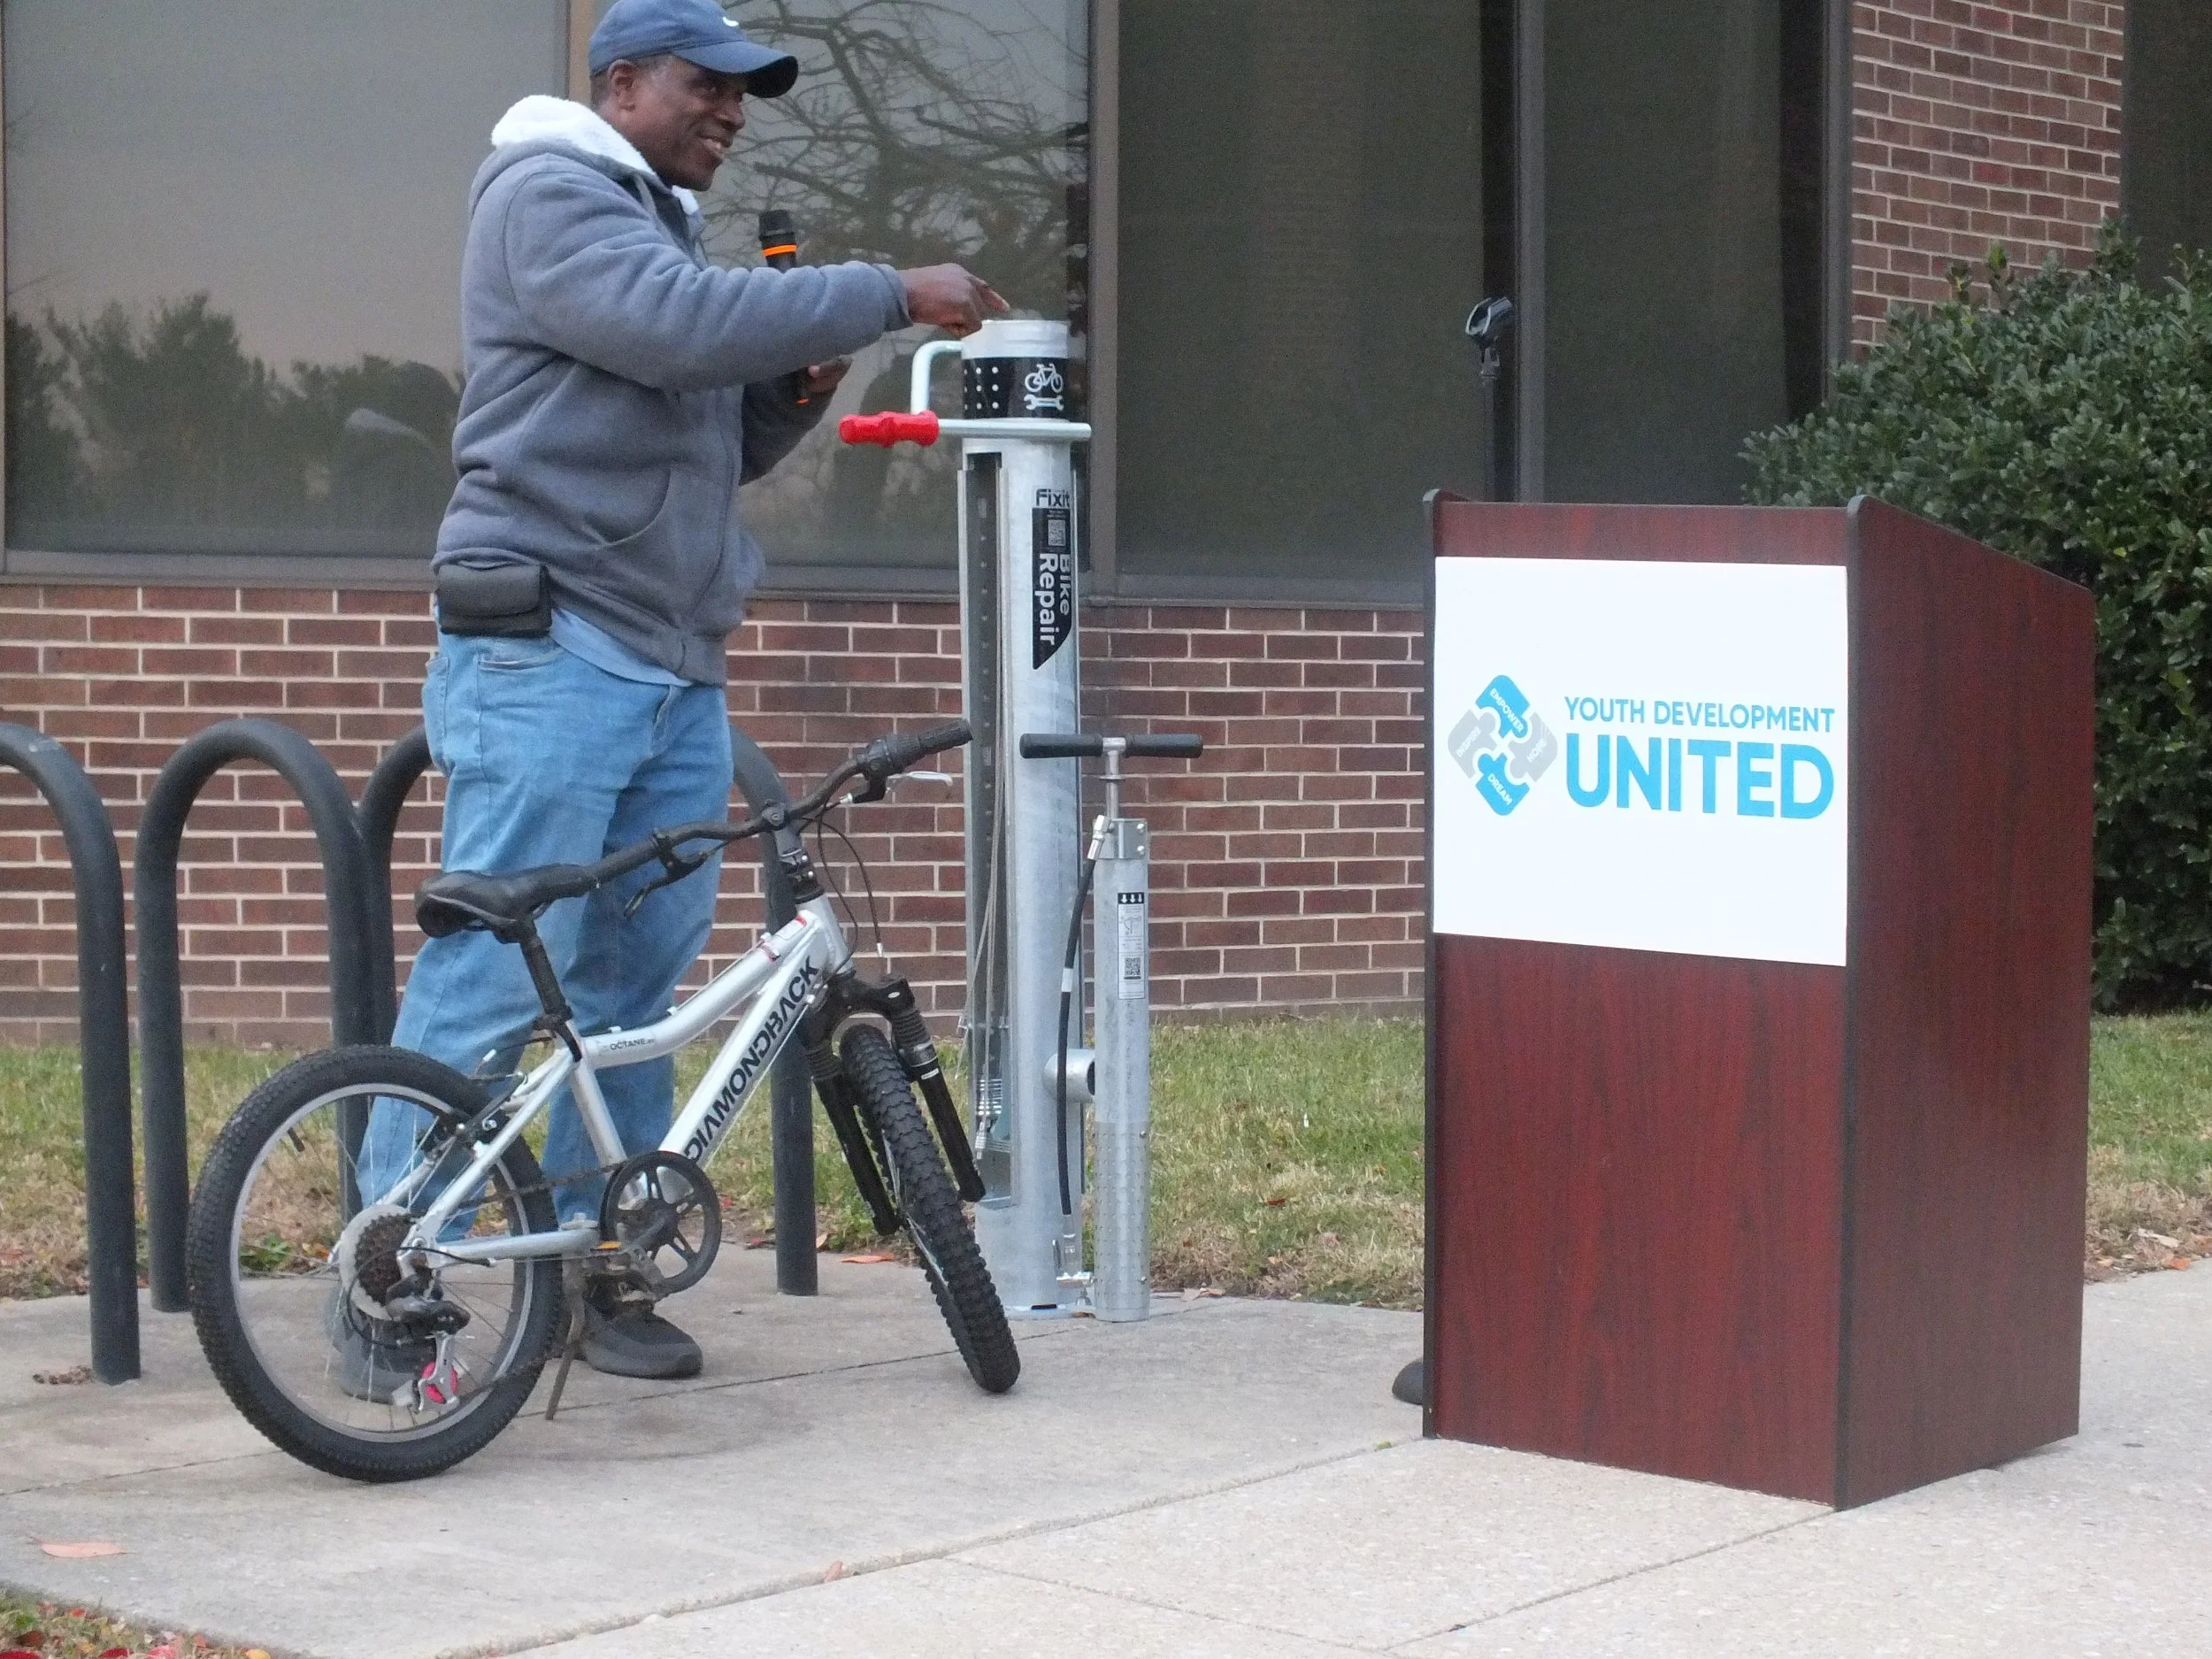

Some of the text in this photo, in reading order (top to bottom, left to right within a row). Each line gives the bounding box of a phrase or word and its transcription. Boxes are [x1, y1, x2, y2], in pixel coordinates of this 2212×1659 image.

[1036, 488, 1071, 508] Fixit
[1034, 553, 1060, 646] Repair
[1059, 553, 1071, 617] Bike
[1489, 687, 1525, 733] EMPOWER
[1564, 696, 1835, 733] YOUTH DEVELOPMENT
[1455, 726, 1482, 757] INSPIRE
[1526, 738, 1548, 764] HOPE
[1487, 773, 1513, 805] DREAM
[1565, 733, 1835, 819] UNITED
[610, 1039, 646, 1050] OCTANE
[683, 956, 818, 1165] DIAMONDBACK
